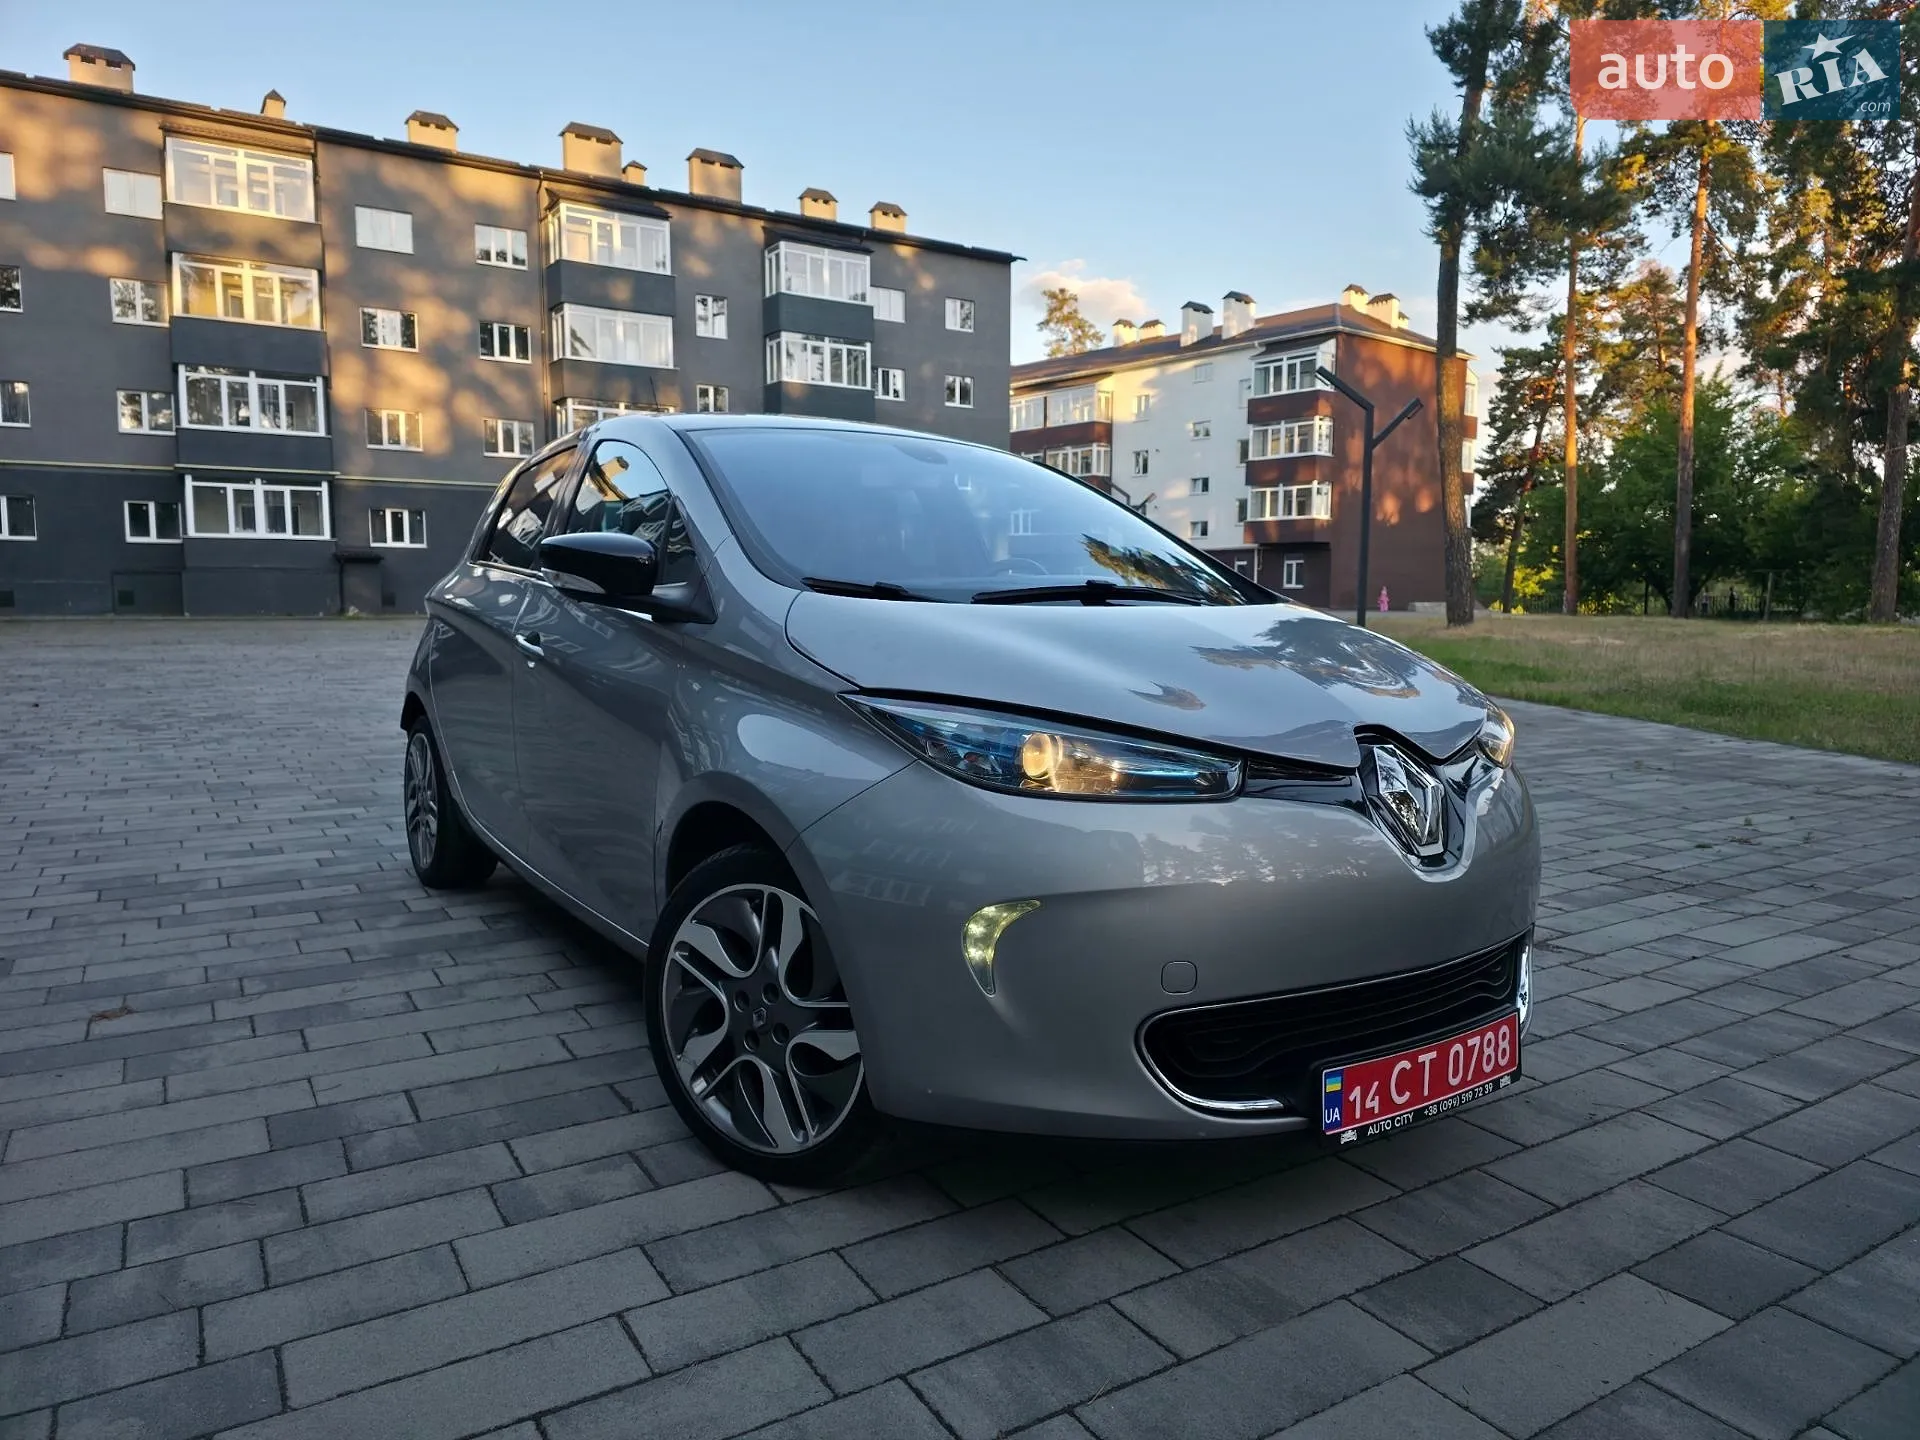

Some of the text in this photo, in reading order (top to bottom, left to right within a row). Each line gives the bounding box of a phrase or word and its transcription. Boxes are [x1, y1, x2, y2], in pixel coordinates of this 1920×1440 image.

[1348, 1024, 1510, 1119] 14 CT 0788
[1423, 1083, 1493, 1117] +38 (099) 519 72 39
[1325, 1108, 1340, 1124] UA
[1367, 1112, 1414, 1136] AUTO CITY
